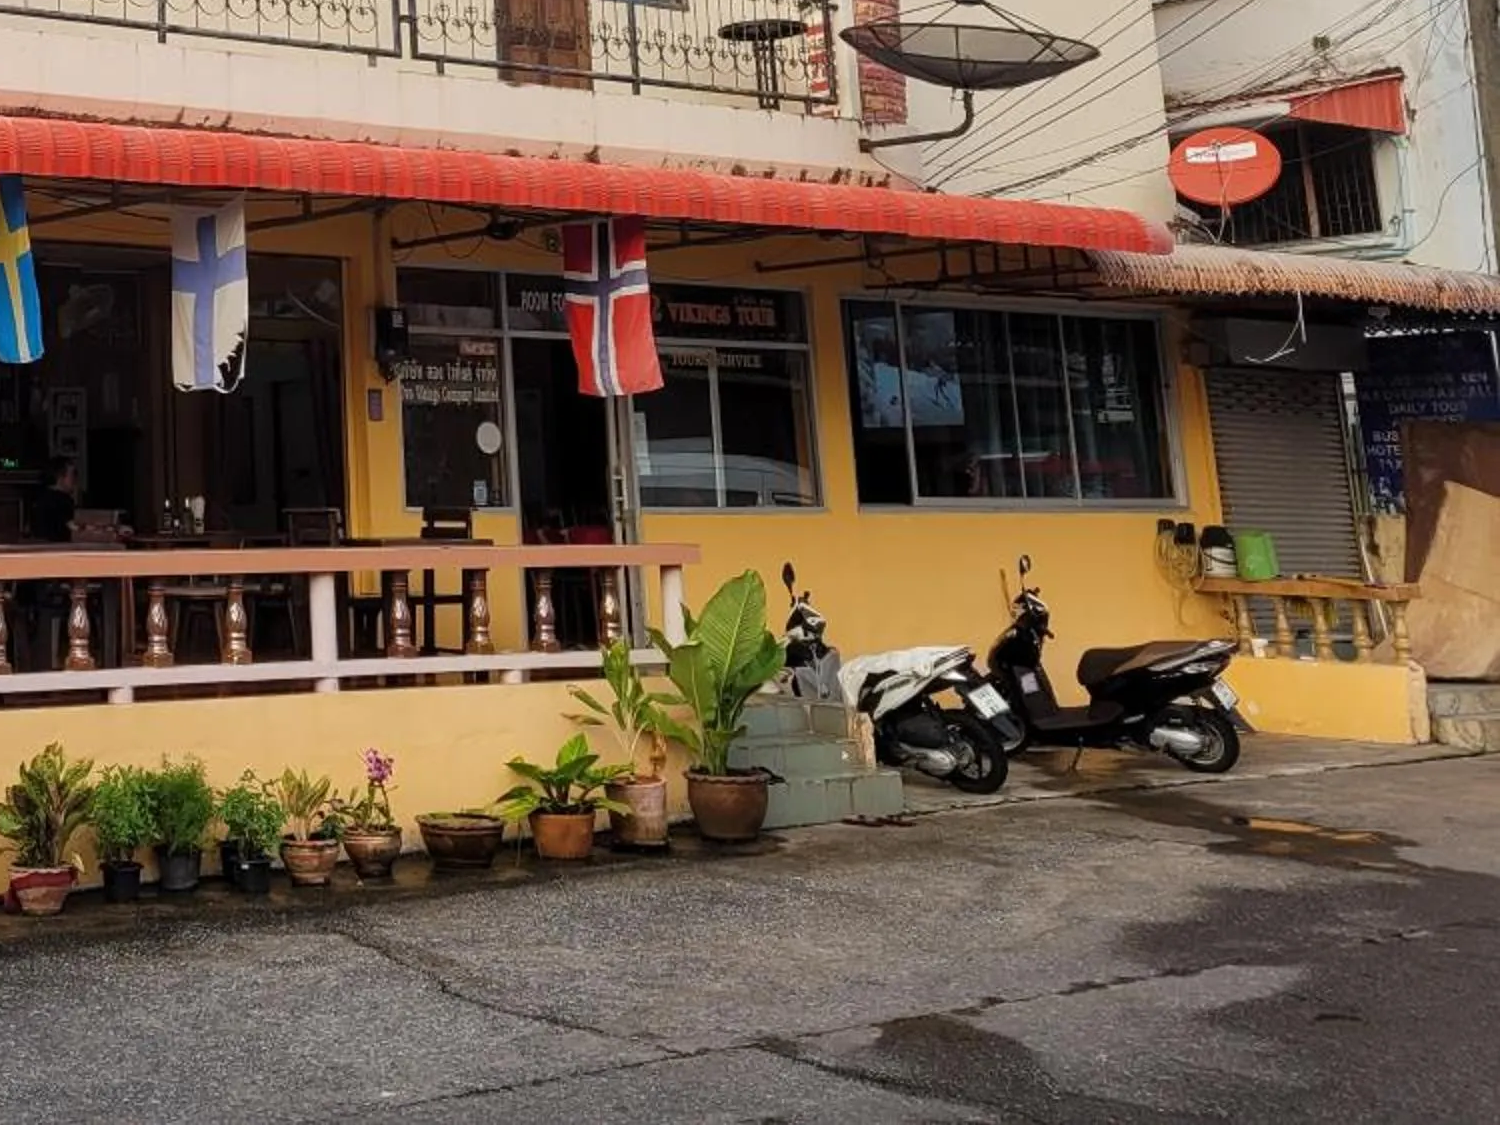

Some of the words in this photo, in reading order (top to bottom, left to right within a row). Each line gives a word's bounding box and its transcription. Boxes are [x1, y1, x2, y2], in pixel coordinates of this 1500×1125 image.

[521, 290, 548, 310] ROOM
[550, 292, 564, 311] FO
[667, 303, 731, 327] VIKINGS
[736, 306, 777, 327] TOUR
[1389, 403, 1425, 415] DAILY
[1367, 444, 1402, 457] HOTE
